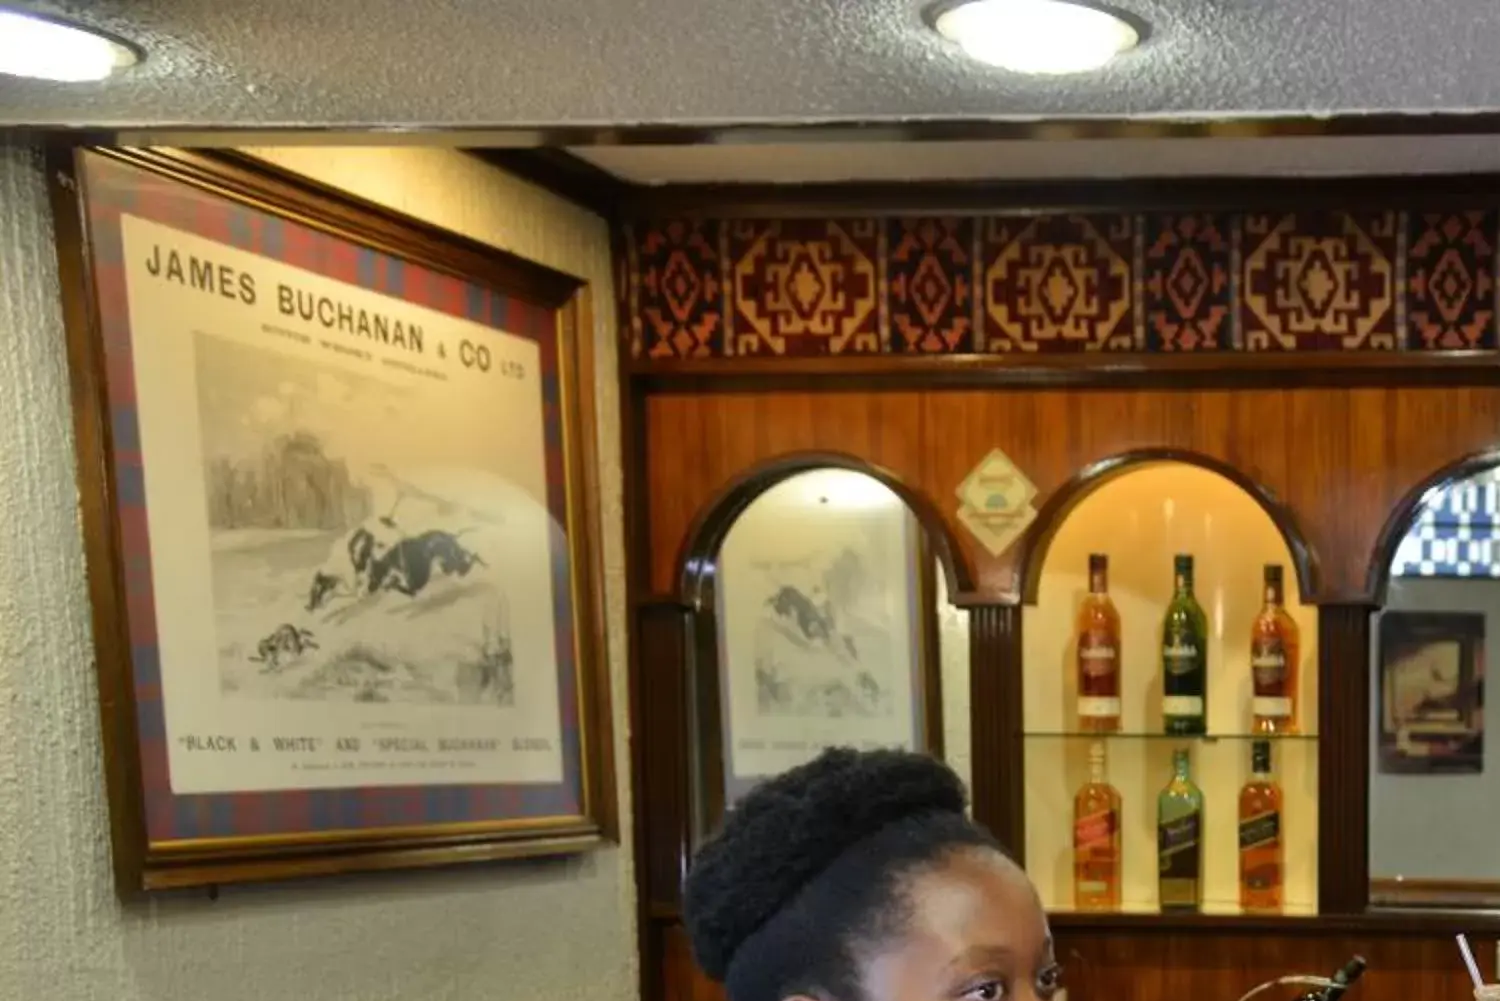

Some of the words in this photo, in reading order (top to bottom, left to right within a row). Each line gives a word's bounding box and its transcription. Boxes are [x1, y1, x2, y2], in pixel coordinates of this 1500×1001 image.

[146, 244, 257, 305] JAMES
[277, 284, 425, 354] BUCHANAN
[458, 339, 492, 373] CO
